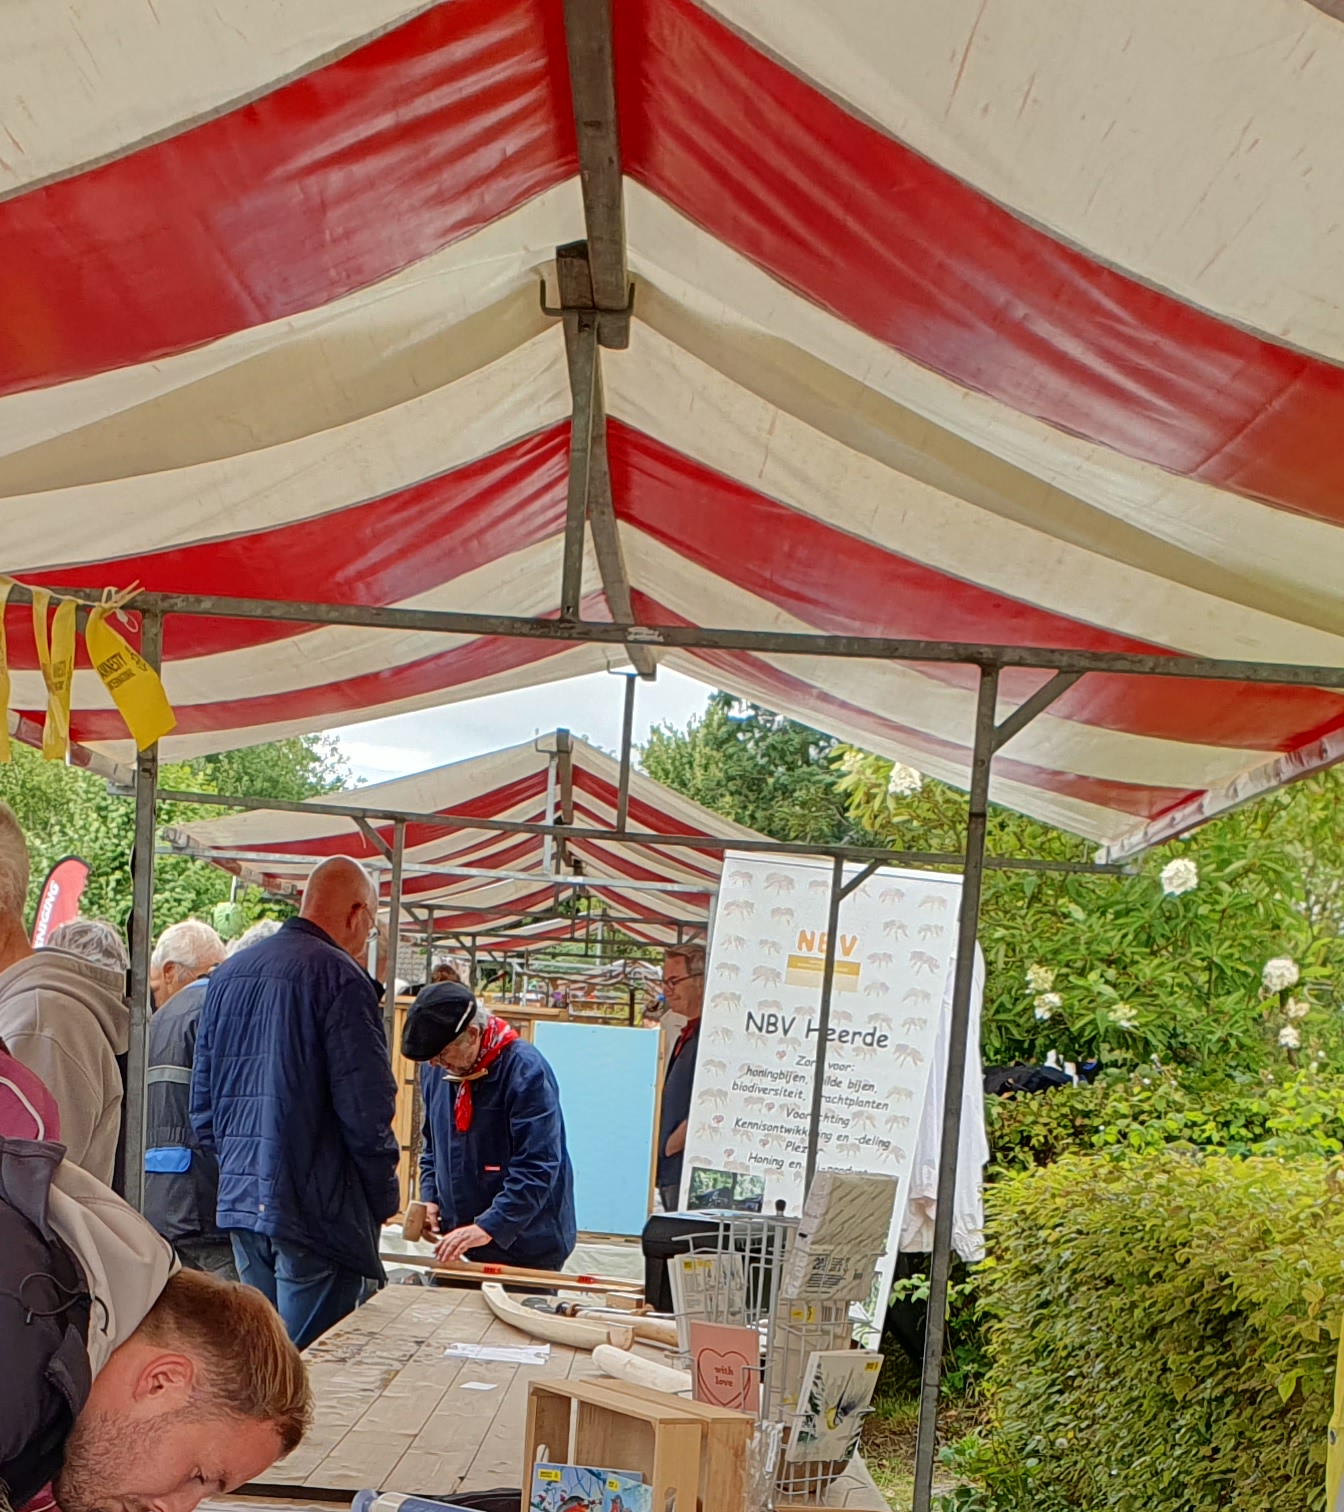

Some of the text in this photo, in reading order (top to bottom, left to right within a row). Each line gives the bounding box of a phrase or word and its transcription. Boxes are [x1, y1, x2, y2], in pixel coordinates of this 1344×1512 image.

[745, 1011, 796, 1037] NBV
[795, 1055, 856, 1072] Zor voor:
[745, 1065, 878, 1094] honingbijen, ilde bijen,
[731, 1081, 889, 1111] biodiversiteit, rachtplanten
[836, 1133, 849, 1142] en
[854, 1134, 891, 1150] -deling
[748, 1152, 785, 1169] Honing
[788, 1160, 802, 1170] en
[714, 1365, 735, 1376] with
[715, 1377, 734, 1388] love
